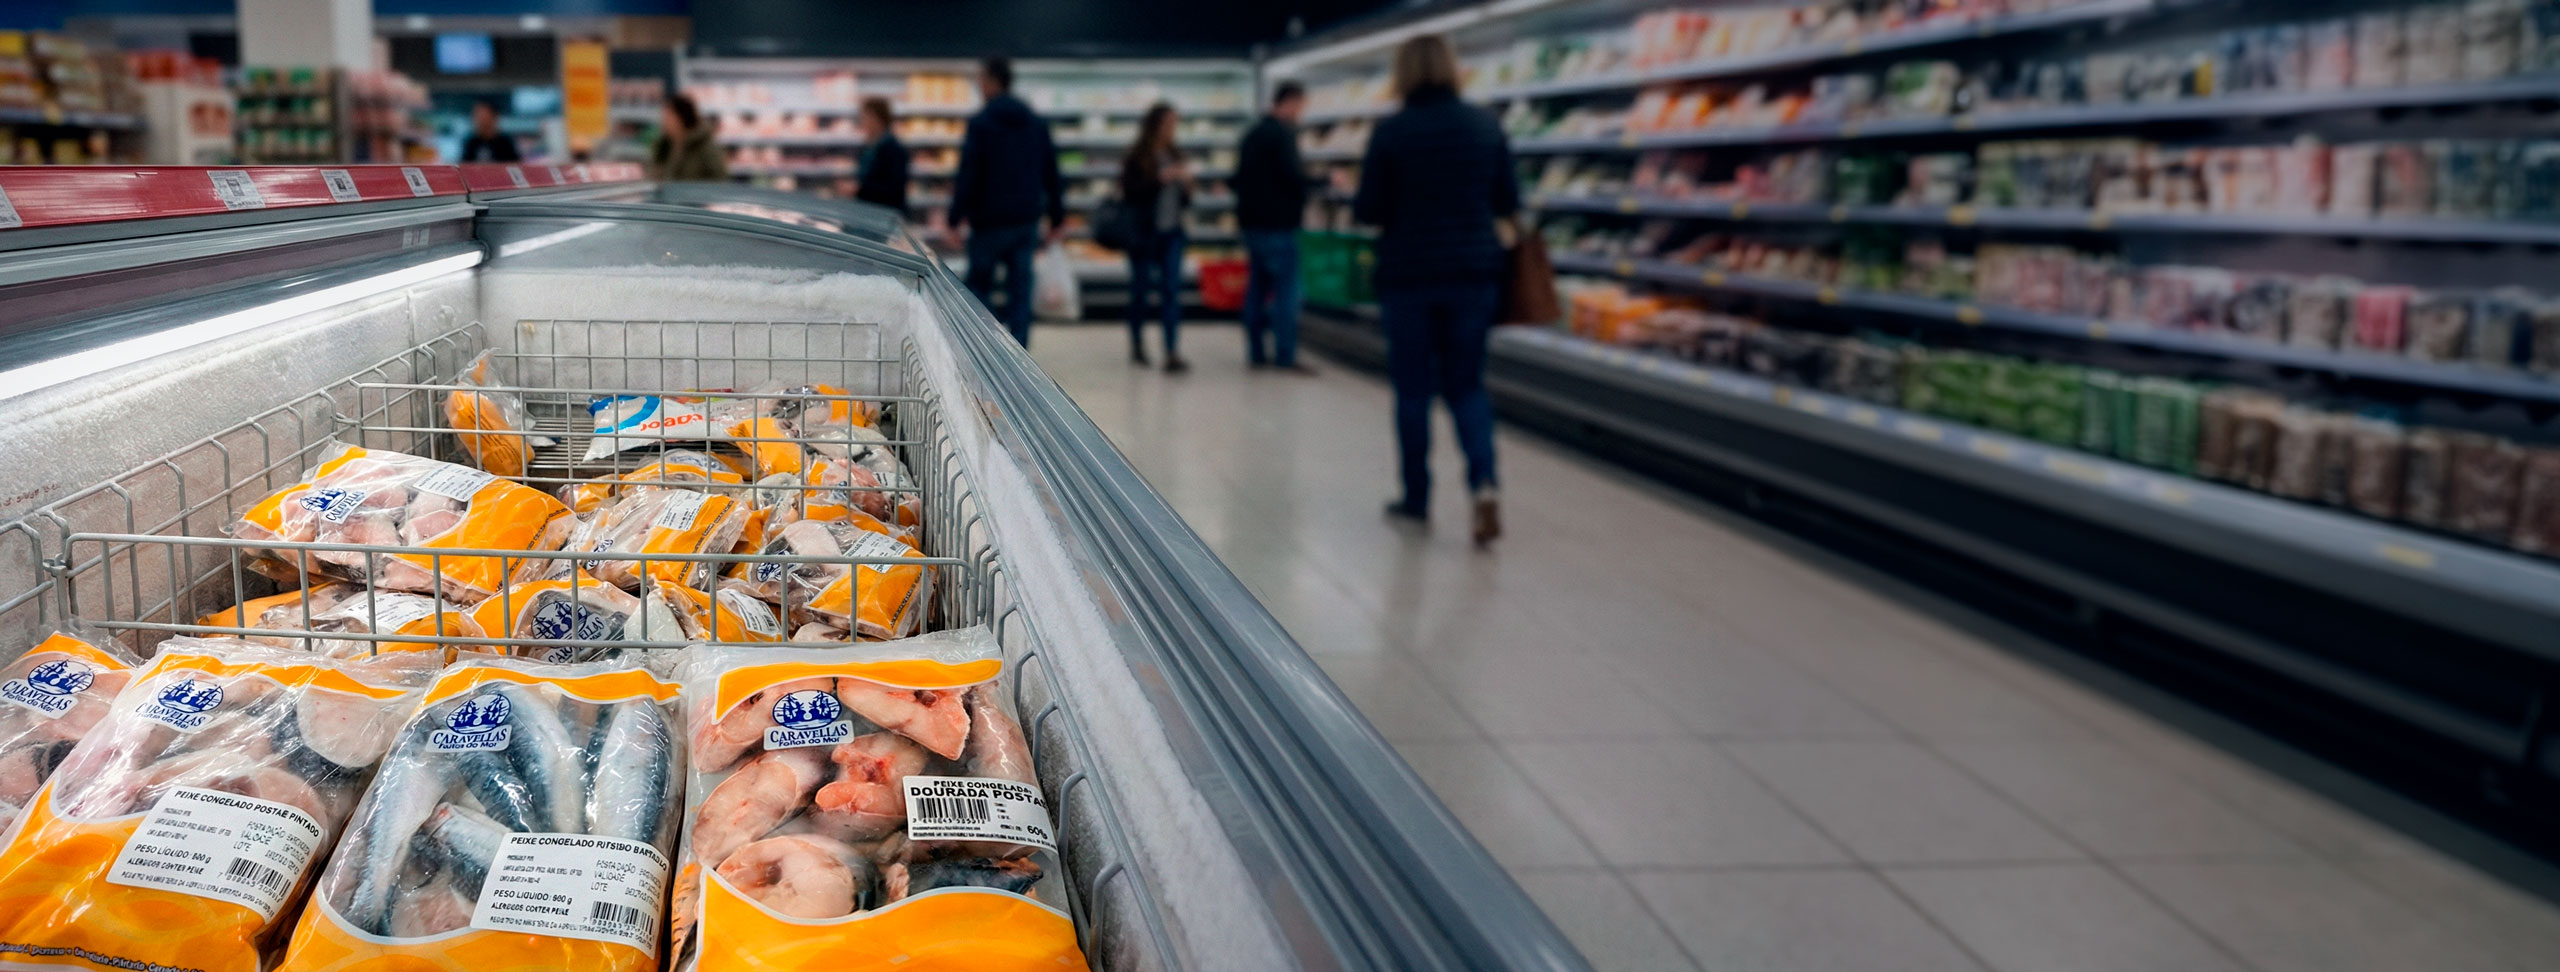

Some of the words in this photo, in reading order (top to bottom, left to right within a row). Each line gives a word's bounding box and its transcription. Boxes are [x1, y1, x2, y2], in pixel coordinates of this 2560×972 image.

[2, 680, 72, 711] CARAVELLAS
[433, 728, 507, 745] CARAVELLAS
[770, 723, 848, 743] CARAVELLAS
[934, 780, 965, 788] PEIXE
[910, 787, 989, 799] DOURADA
[174, 791, 200, 802] PEIXE
[200, 795, 253, 811] CONGELADO
[290, 812, 320, 838] PINTADO
[511, 837, 538, 845] PEIXE
[538, 837, 595, 848] CONGELADO
[134, 844, 158, 854] PESO
[493, 889, 516, 898] PESO
